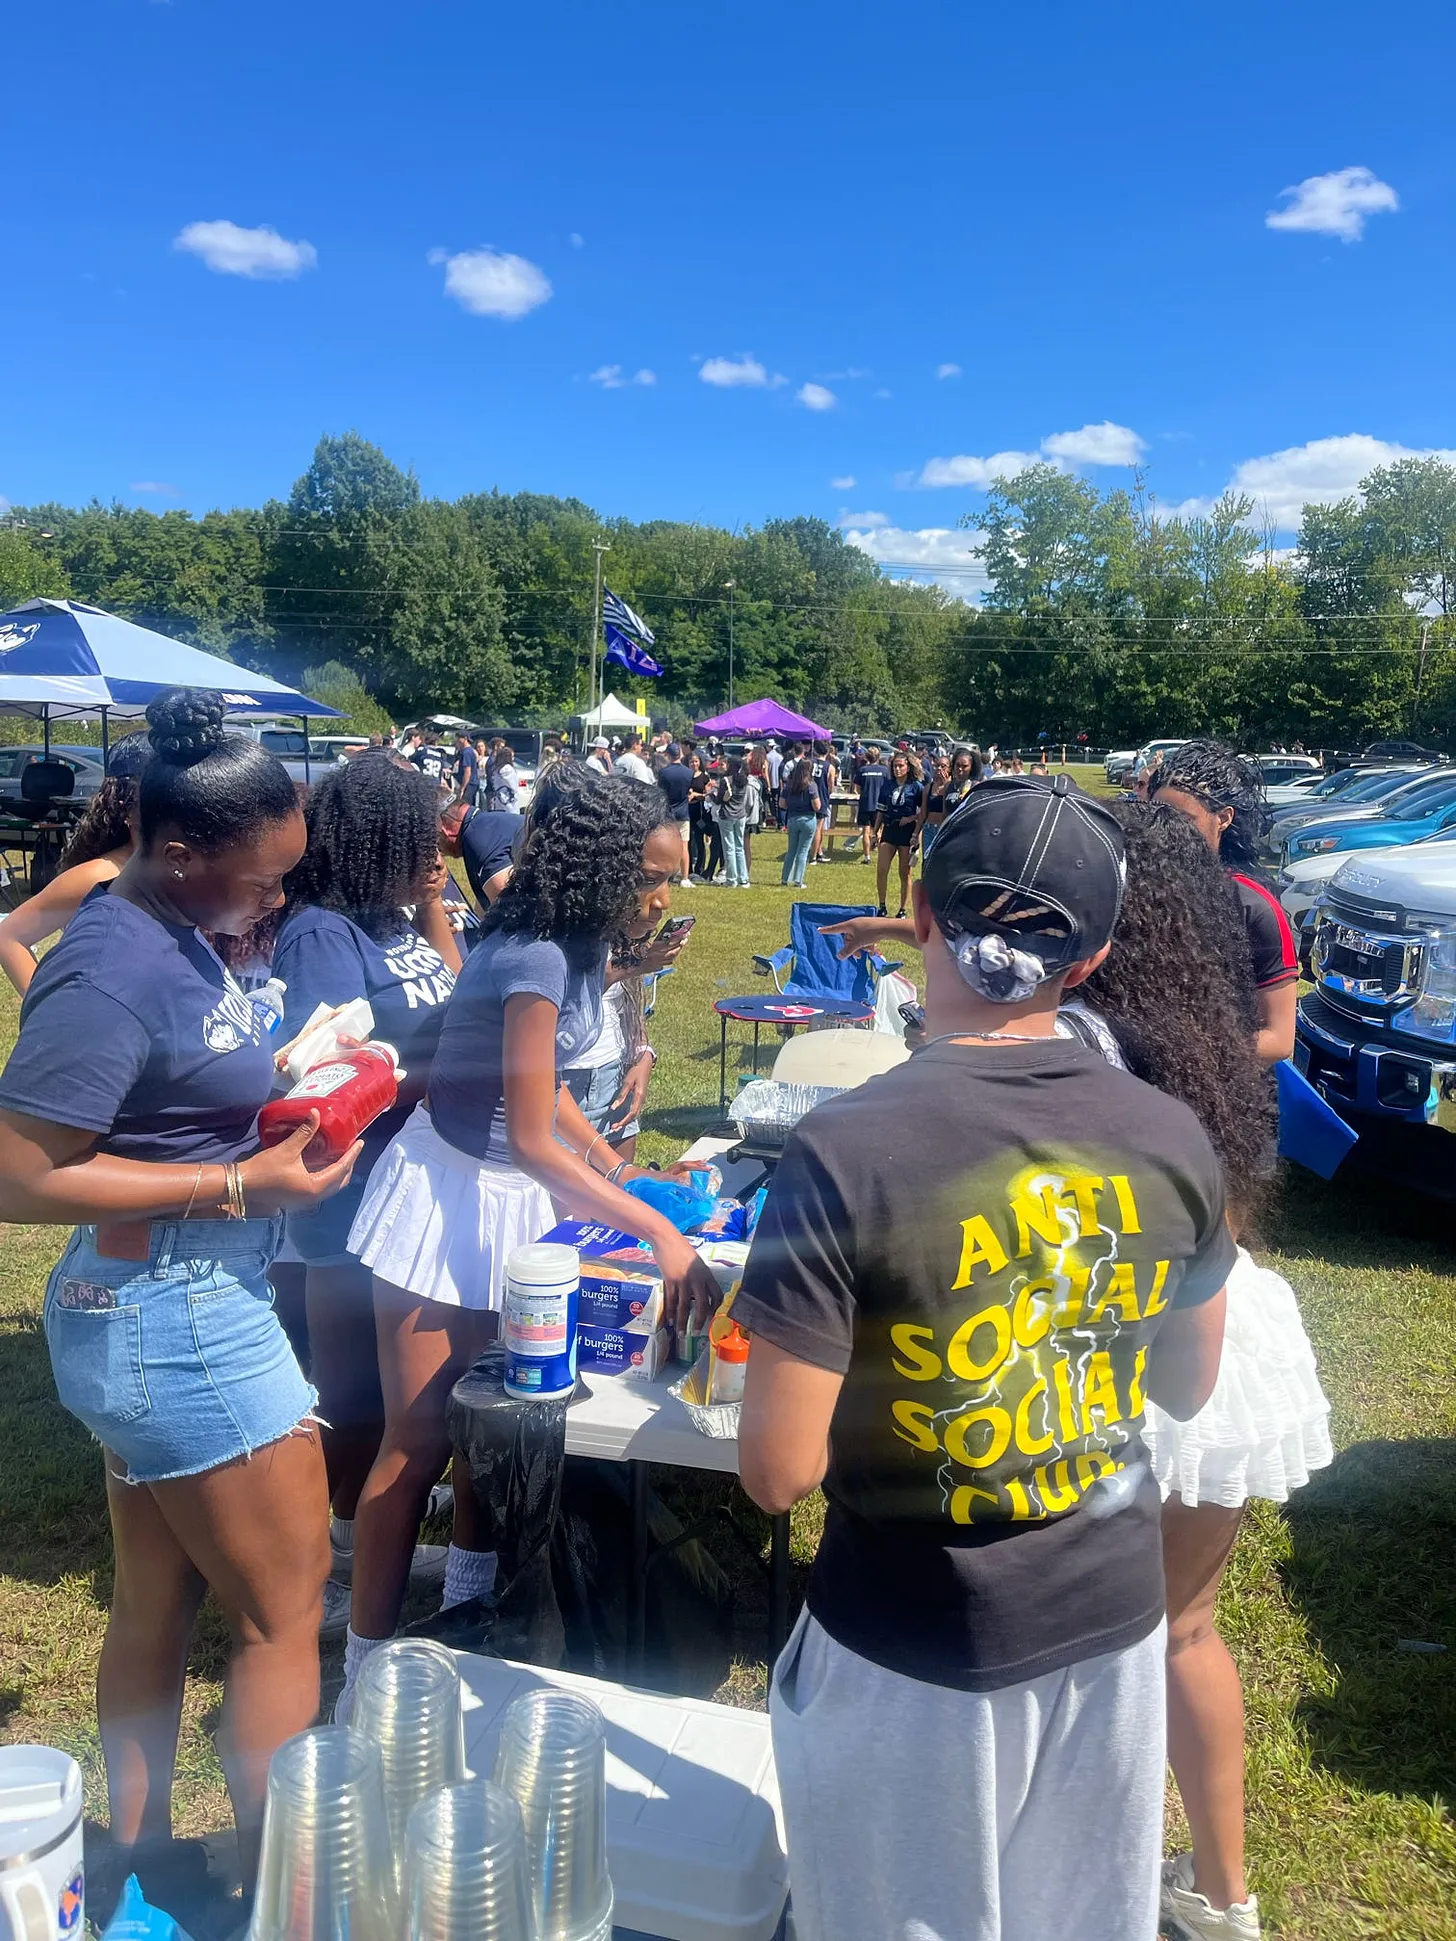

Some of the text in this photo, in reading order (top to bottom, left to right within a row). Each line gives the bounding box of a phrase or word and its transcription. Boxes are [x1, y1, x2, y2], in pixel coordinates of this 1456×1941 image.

[950, 1175, 1142, 1291] ANTI
[581, 1288, 619, 1302] burgers
[600, 1285, 619, 1294] 100%
[602, 1302, 619, 1310] pound
[890, 1260, 1170, 1381] SOCIAL
[584, 1336, 624, 1352] burgers
[604, 1333, 624, 1344] 100%
[605, 1352, 623, 1360] pound
[891, 1345, 1147, 1469] SOCIAL
